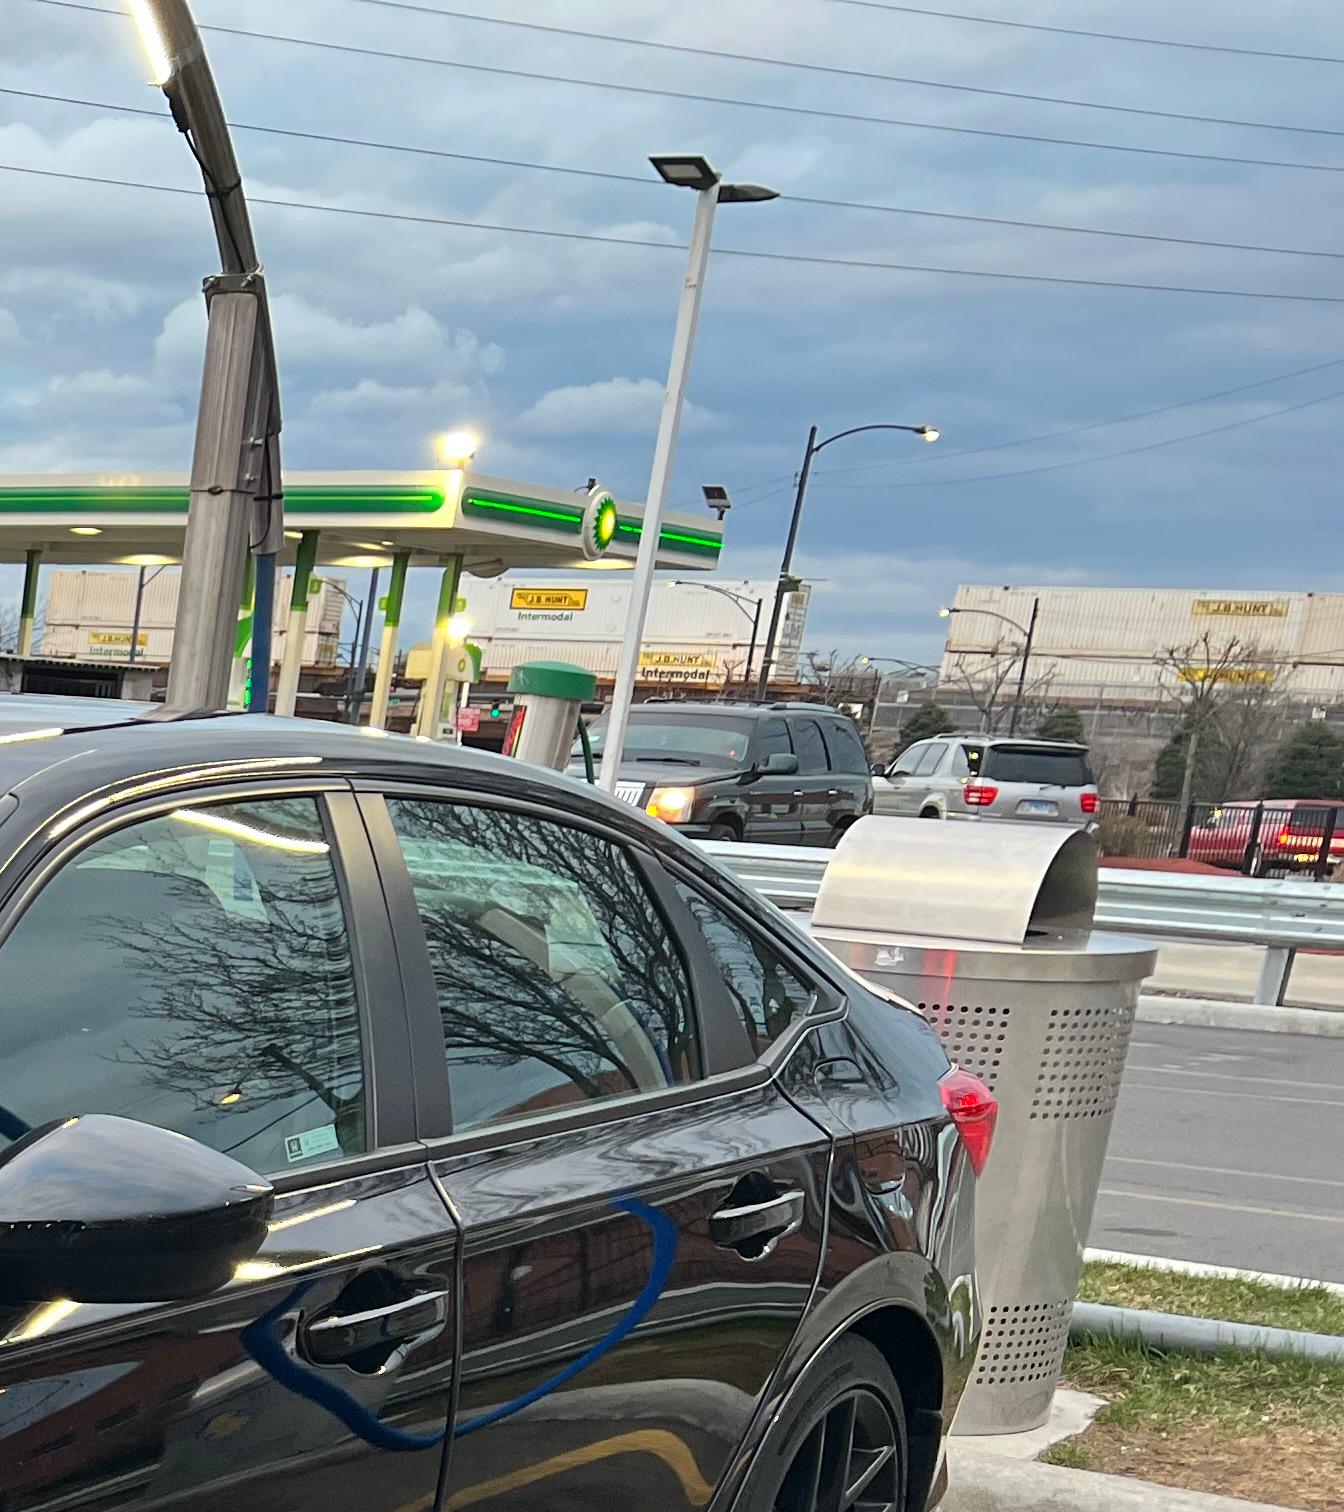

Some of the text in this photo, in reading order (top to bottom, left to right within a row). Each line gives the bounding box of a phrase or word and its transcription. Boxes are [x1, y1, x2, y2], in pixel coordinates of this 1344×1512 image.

[545, 595, 568, 604] HUNT
[1234, 602, 1268, 613] HUNT
[517, 611, 574, 621] Intermodal
[89, 646, 144, 657] Intermoal
[673, 655, 700, 665] HUNT
[641, 667, 711, 680] Intermodal
